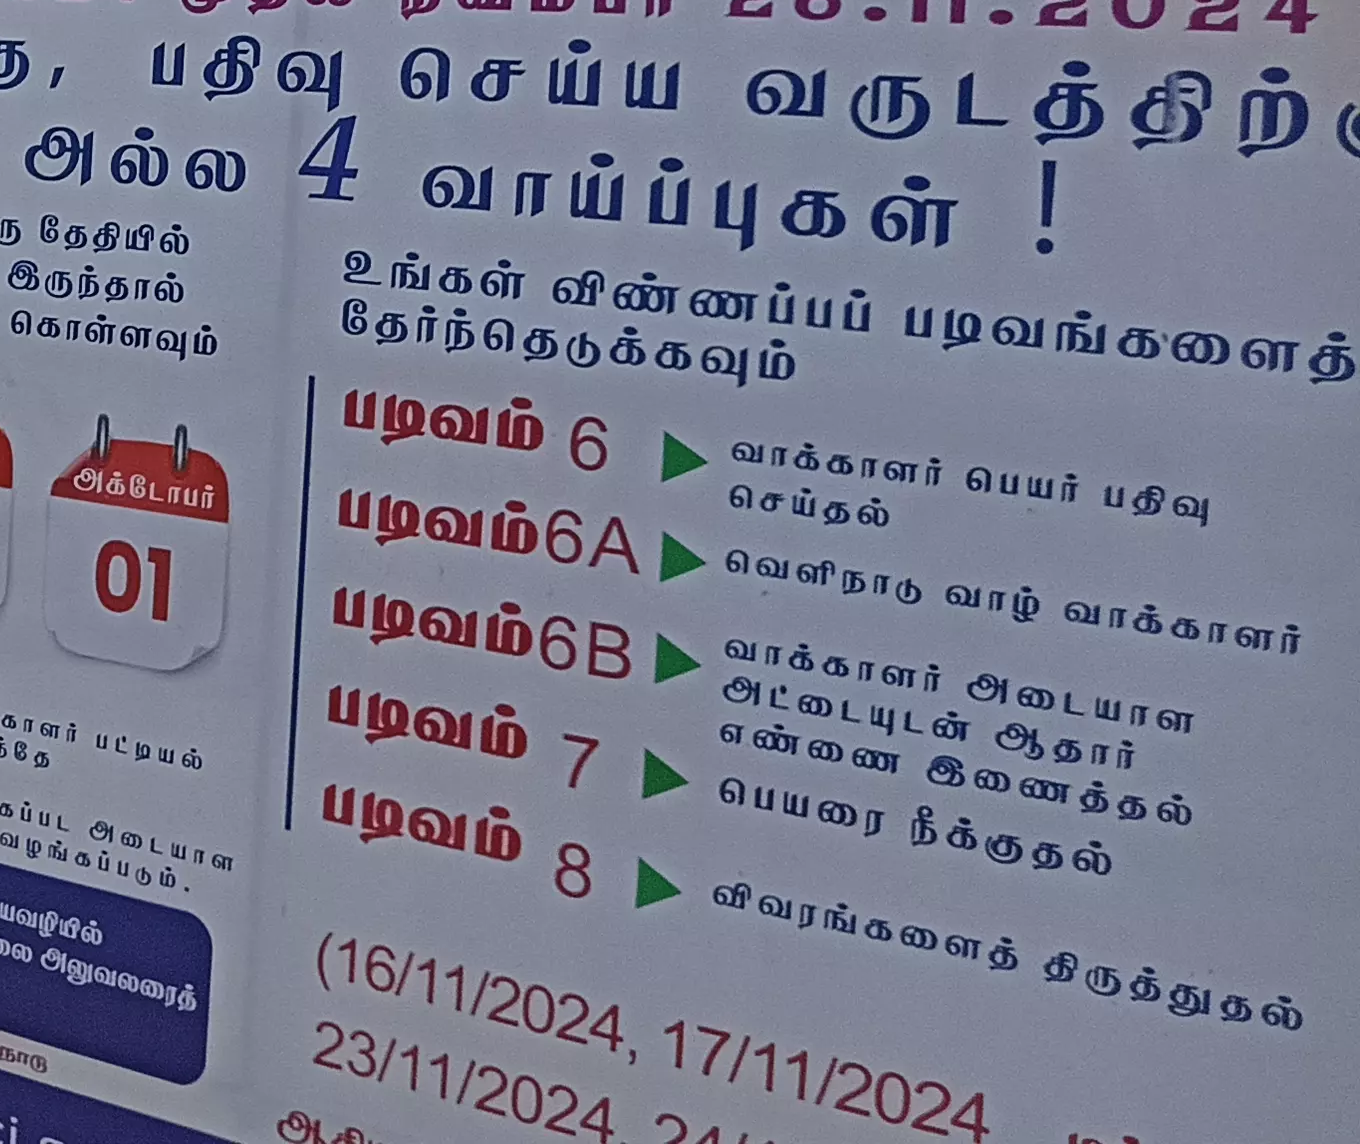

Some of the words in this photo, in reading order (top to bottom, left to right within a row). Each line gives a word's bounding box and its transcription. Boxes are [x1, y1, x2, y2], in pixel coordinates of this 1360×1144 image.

[152, 35, 342, 112] பதிவு
[401, 39, 680, 110] செய்ய
[25, 127, 246, 192] அல்ல
[298, 115, 358, 201] 4
[423, 153, 959, 251] வாய்ப்புகள்
[40, 214, 189, 254] தேதியில்
[8, 260, 184, 303] இருந்தால்
[344, 251, 525, 299] உங்கள்
[553, 270, 871, 335] விண்ணப்பப்
[904, 306, 1355, 384] படிவங்களைத்
[11, 310, 217, 361] கொள்ளவும்
[340, 295, 796, 389] தேர்ந்தெடுக்கவும்
[73, 467, 217, 511] அக்டோபர்
[344, 389, 543, 451] படிவம்
[570, 417, 607, 471] 6
[732, 442, 942, 486] வாக்காளர்
[966, 467, 1079, 502] பெயர்
[1104, 485, 1209, 527] பதிவு
[729, 485, 889, 527] செய்தல்
[96, 540, 171, 621] 01
[725, 549, 922, 604] வெளிநாடு
[945, 585, 1040, 623] வாழ்
[1064, 602, 1301, 654] வாக்காளர்
[721, 673, 973, 744] அட்டையுடன்
[995, 723, 1135, 769] ஆதார்
[724, 639, 941, 694] வாக்காளர்
[967, 674, 1194, 734] அடையாள
[96, 734, 202, 770] பட்டியல்
[328, 685, 527, 758] படிவம்
[563, 733, 600, 788] 7
[719, 778, 885, 837] பெயரை
[911, 806, 1112, 875] நீக்குதல்
[720, 724, 900, 774] எண்ணை
[927, 749, 1192, 825] இணைத்தல்
[89, 821, 233, 877] அடையாள
[323, 784, 521, 861] படிவம்
[555, 843, 591, 898] 8
[713, 883, 1018, 970] விவரங்களைத்
[1043, 952, 1303, 1031] திருத்துதல்
[40, 947, 198, 1012] அலுவலரைத்
[313, 932, 637, 1070] (16/11/2024,
